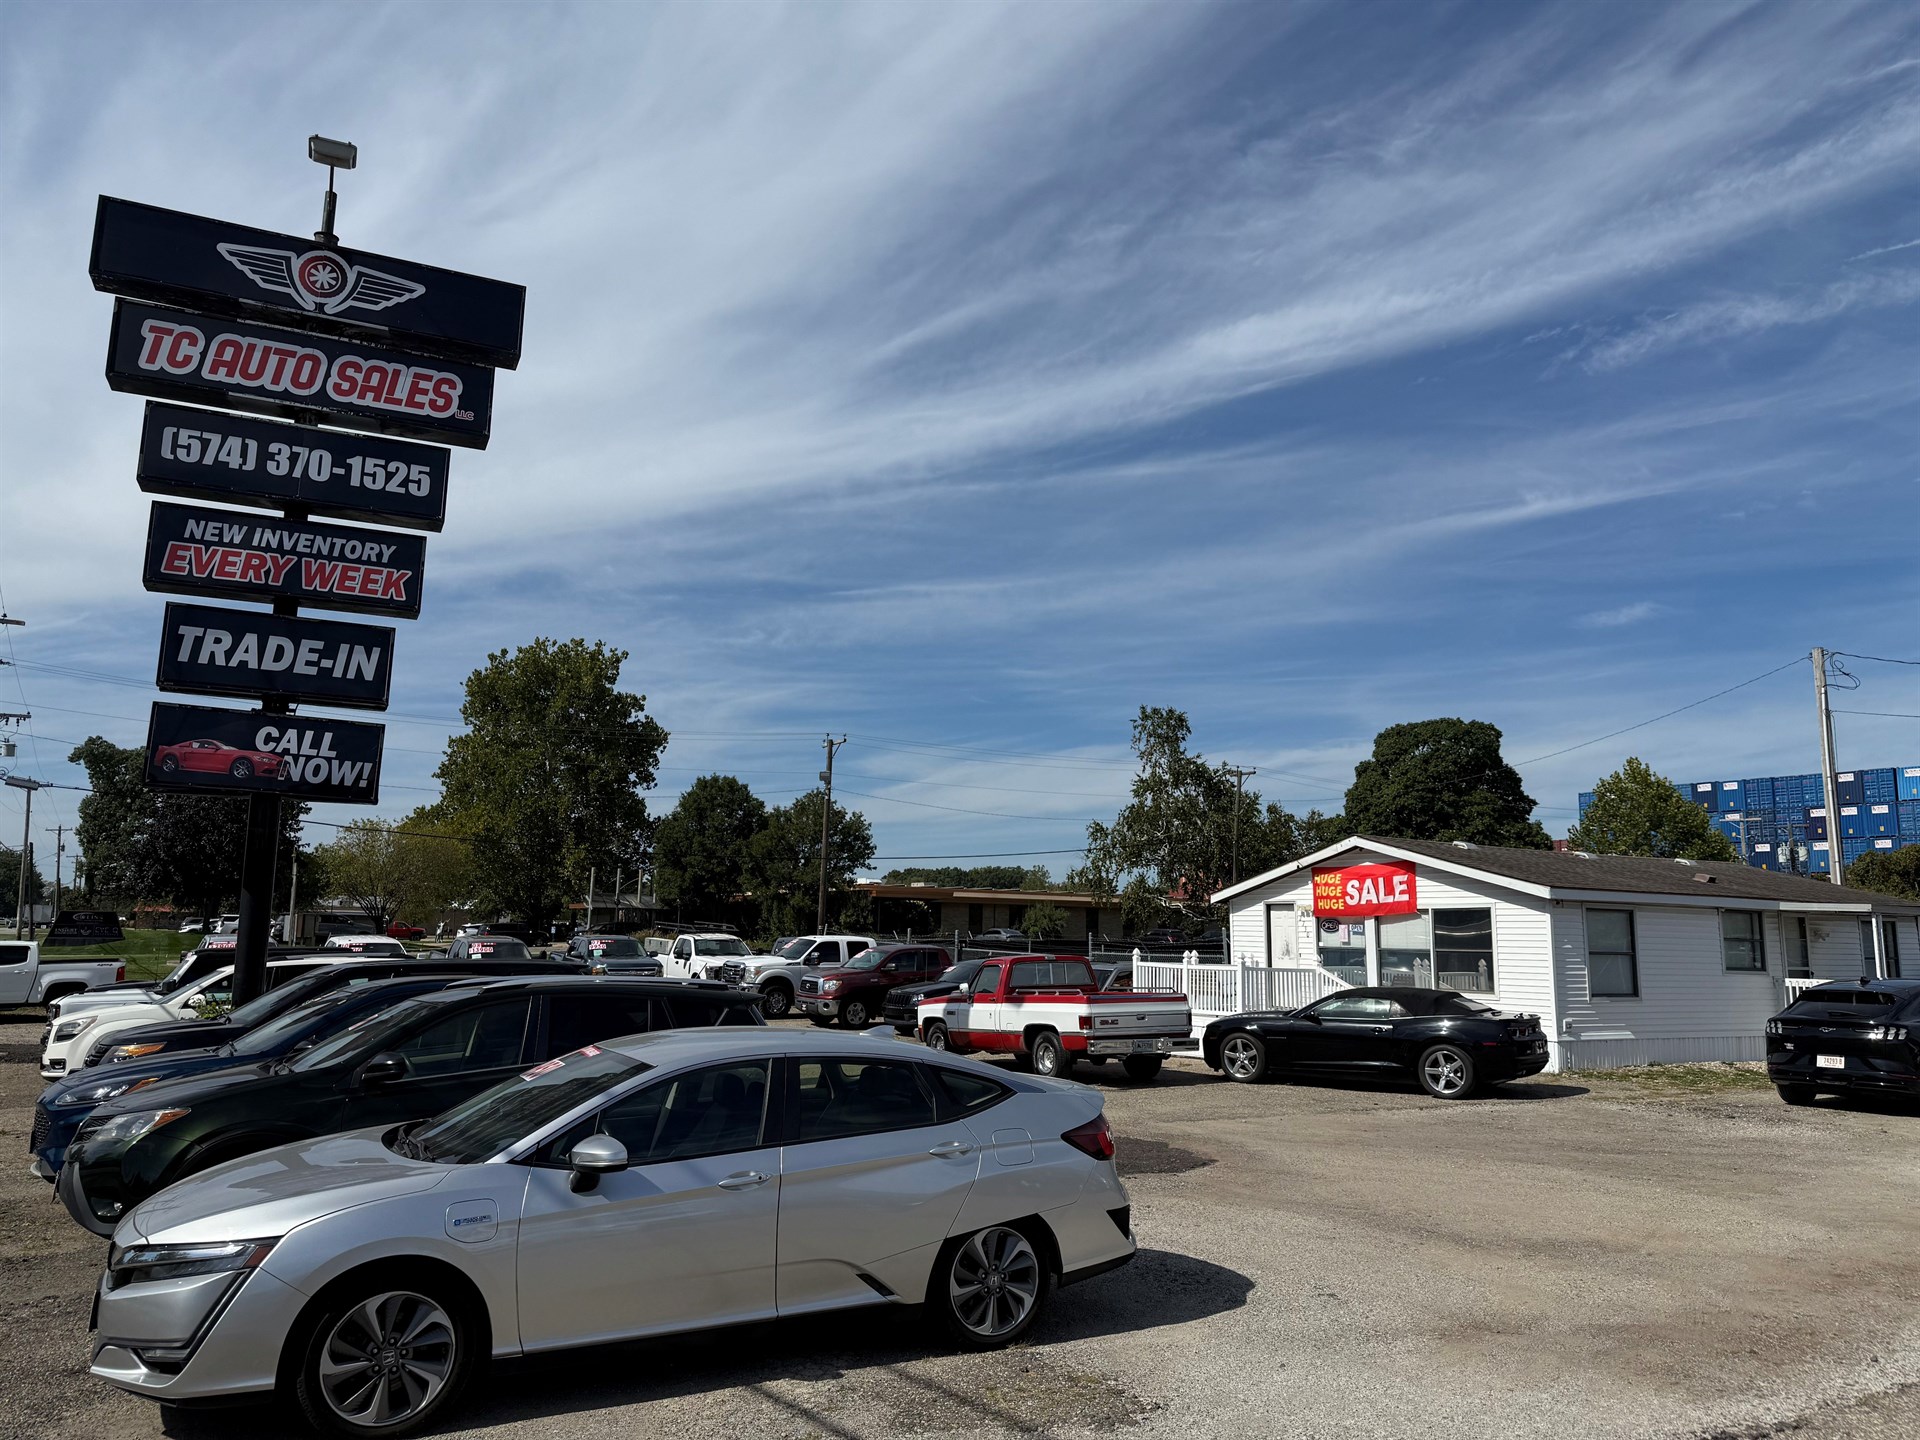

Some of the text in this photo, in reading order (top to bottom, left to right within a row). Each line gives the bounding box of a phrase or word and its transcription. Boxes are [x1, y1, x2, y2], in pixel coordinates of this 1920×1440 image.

[138, 319, 474, 421] TC AUTO SALES LLC
[160, 426, 431, 497] (574) 370-1525
[184, 518, 398, 563] NEW INVENTORY
[161, 541, 412, 601] EVERY WEEK
[177, 625, 381, 681] TRADE-IN
[255, 726, 338, 757] CALL
[277, 755, 373, 788] NOW!
[1314, 873, 1342, 884] HUGE
[1316, 886, 1343, 896] HUGE
[1345, 875, 1410, 906] SALE
[1318, 899, 1344, 910] HUGE
